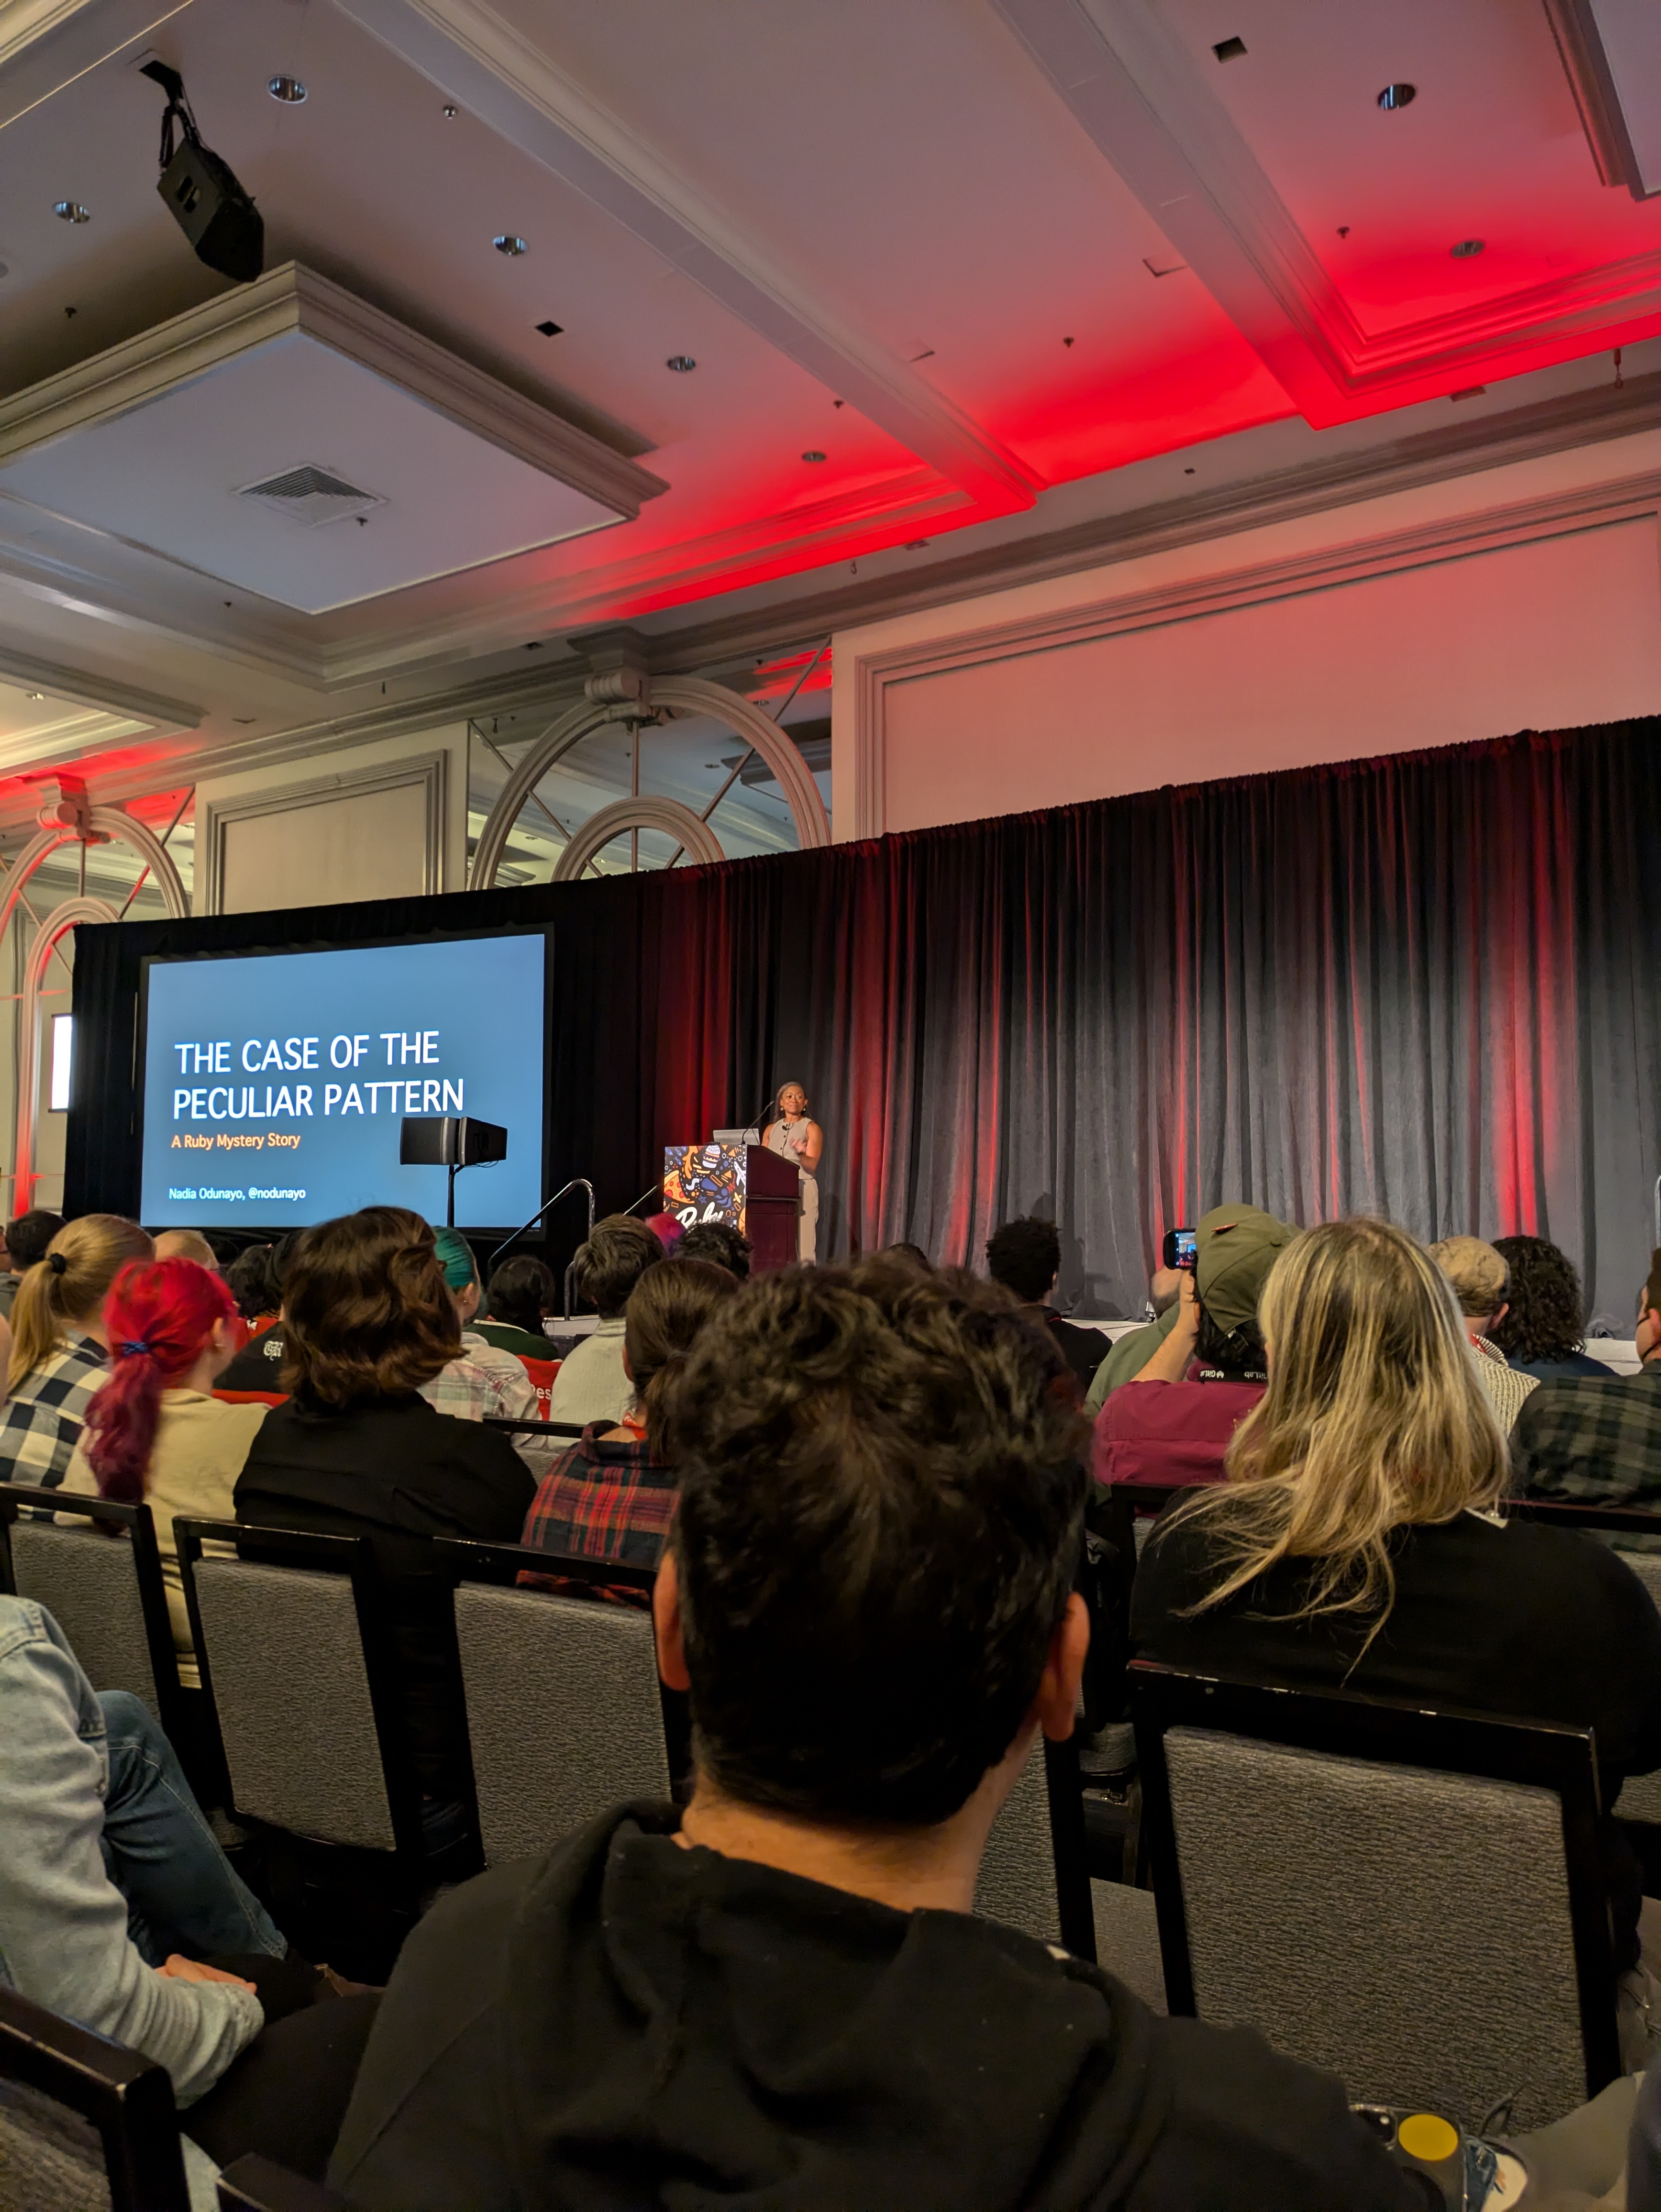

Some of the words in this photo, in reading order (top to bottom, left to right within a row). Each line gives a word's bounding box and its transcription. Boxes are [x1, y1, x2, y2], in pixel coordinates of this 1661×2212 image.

[175, 1042, 231, 1074] THE
[242, 1037, 319, 1072] CASE
[330, 1034, 370, 1069] OF
[380, 1030, 439, 1065] THE
[174, 1085, 313, 1119] PECULIAR
[324, 1078, 464, 1115] PATTERN
[171, 1135, 181, 1148] A
[184, 1134, 214, 1150] Ruby
[217, 1134, 265, 1150] Mystery
[268, 1132, 300, 1149] Story
[169, 1188, 197, 1200] Nadia
[199, 1187, 245, 1202] Odunayo,
[248, 1187, 306, 1201] @nodunayo
[675, 1202, 723, 1229] Rby
[531, 1384, 551, 1400] es
